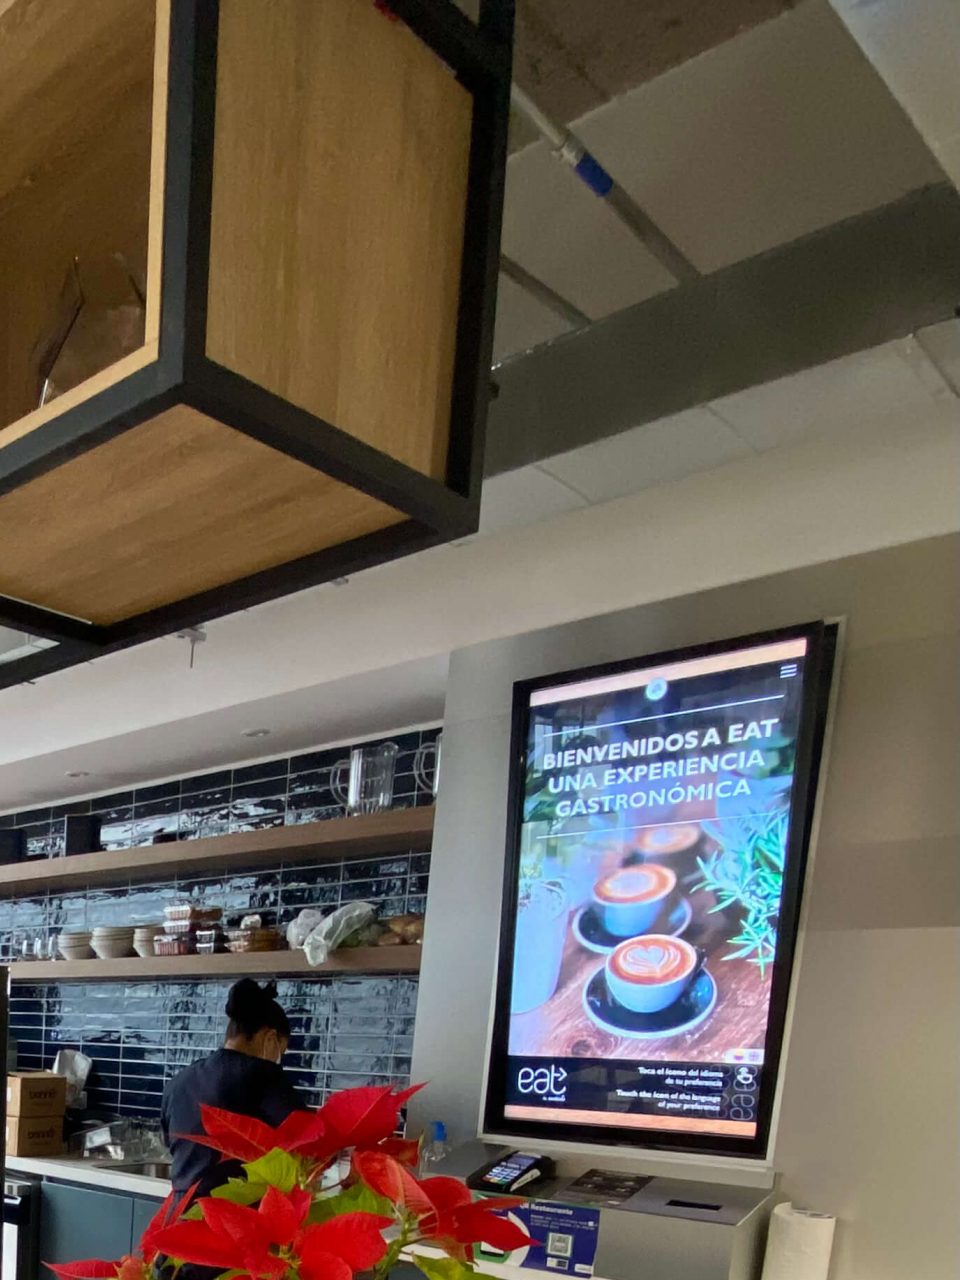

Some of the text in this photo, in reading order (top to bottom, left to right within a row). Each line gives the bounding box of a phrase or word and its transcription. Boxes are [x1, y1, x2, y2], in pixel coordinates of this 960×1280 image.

[543, 718, 779, 770] BIENVENIDOS A EAT
[548, 749, 765, 794] UNA EXPERIENCIA
[555, 779, 751, 817] GASTRONÓMICA
[518, 1064, 567, 1095] eat
